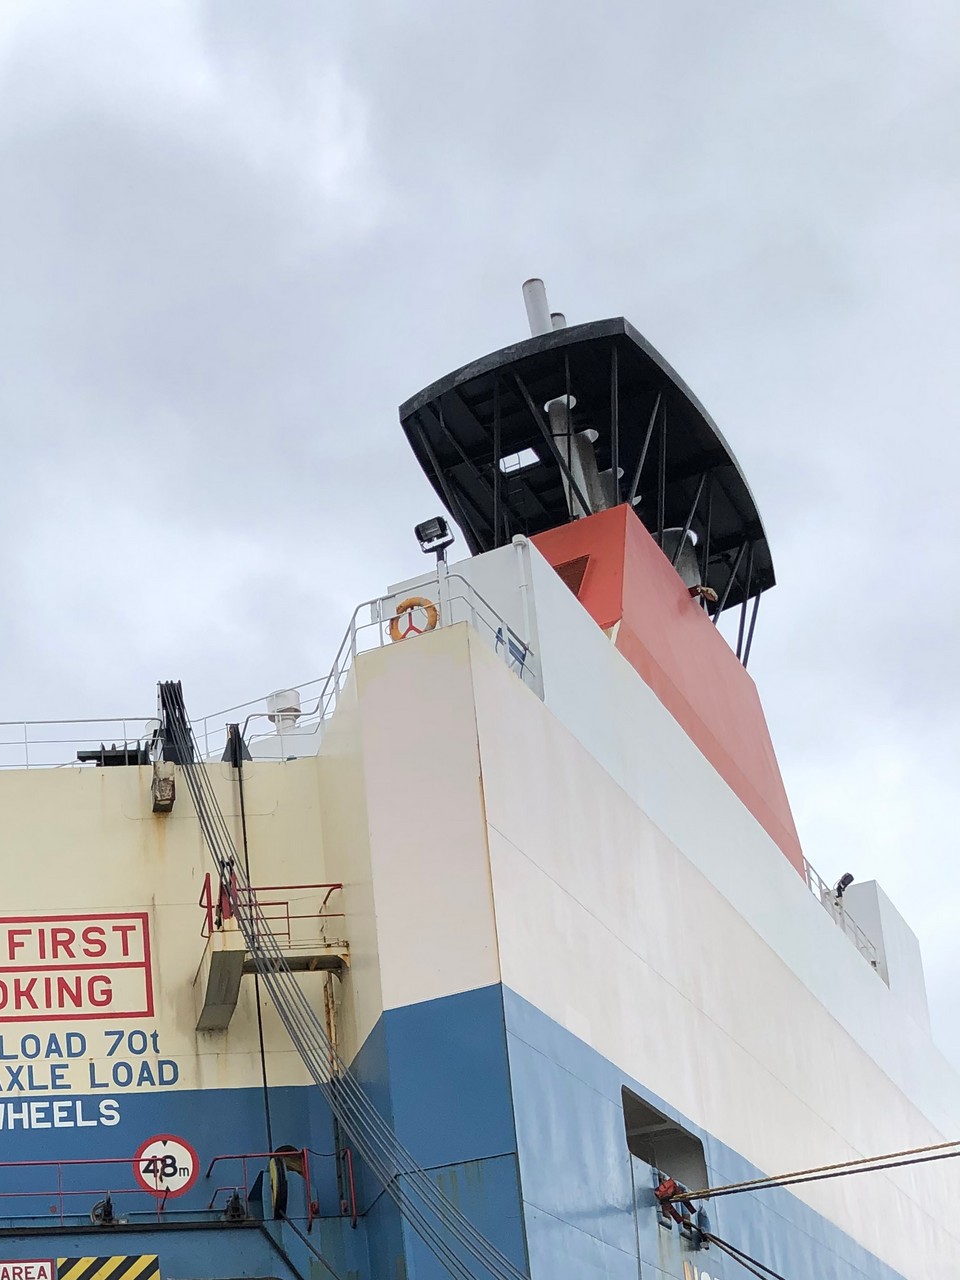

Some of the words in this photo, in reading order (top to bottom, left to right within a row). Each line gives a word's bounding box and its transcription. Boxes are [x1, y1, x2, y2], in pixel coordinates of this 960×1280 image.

[7, 925, 137, 960] FIRST
[104, 1029, 160, 1057] 70t
[89, 1060, 179, 1088] LOAD
